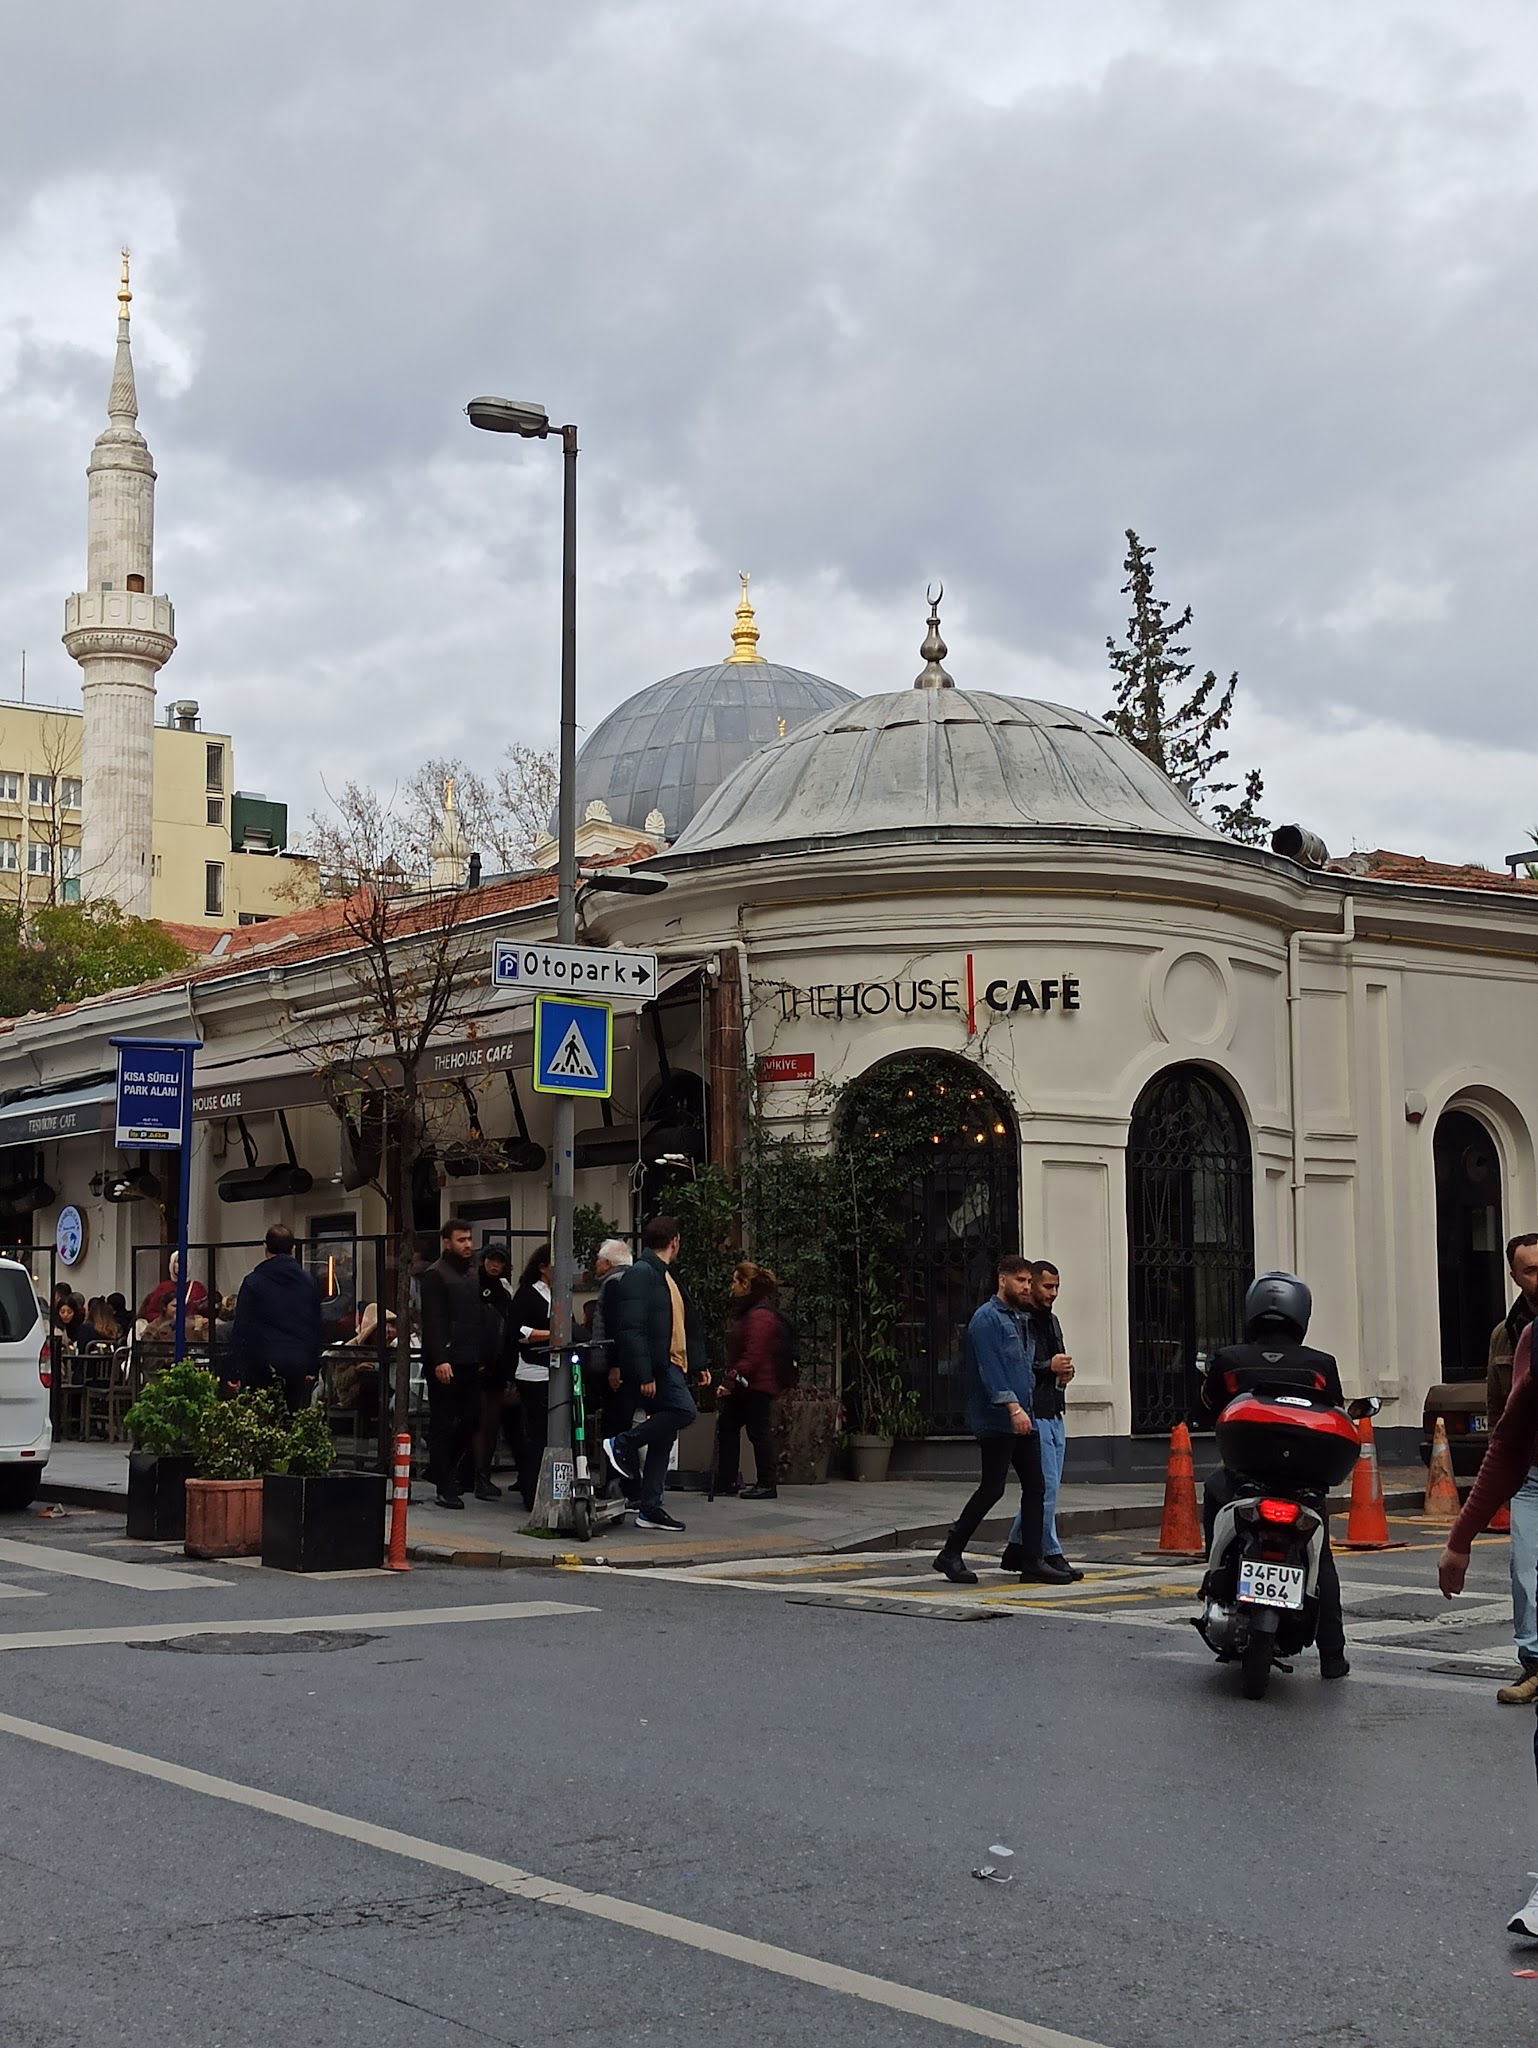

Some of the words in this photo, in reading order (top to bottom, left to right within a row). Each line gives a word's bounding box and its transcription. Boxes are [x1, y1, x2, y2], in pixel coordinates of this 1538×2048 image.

[524, 951, 627, 985] Otopark
[123, 1071, 145, 1083] KISA
[147, 1071, 179, 1084] SÜRELİ
[123, 1084, 148, 1096] PARK
[150, 1085, 178, 1097] ALANI
[1243, 1563, 1302, 1585] 34FUV
[1254, 1582, 1289, 1600] 964
